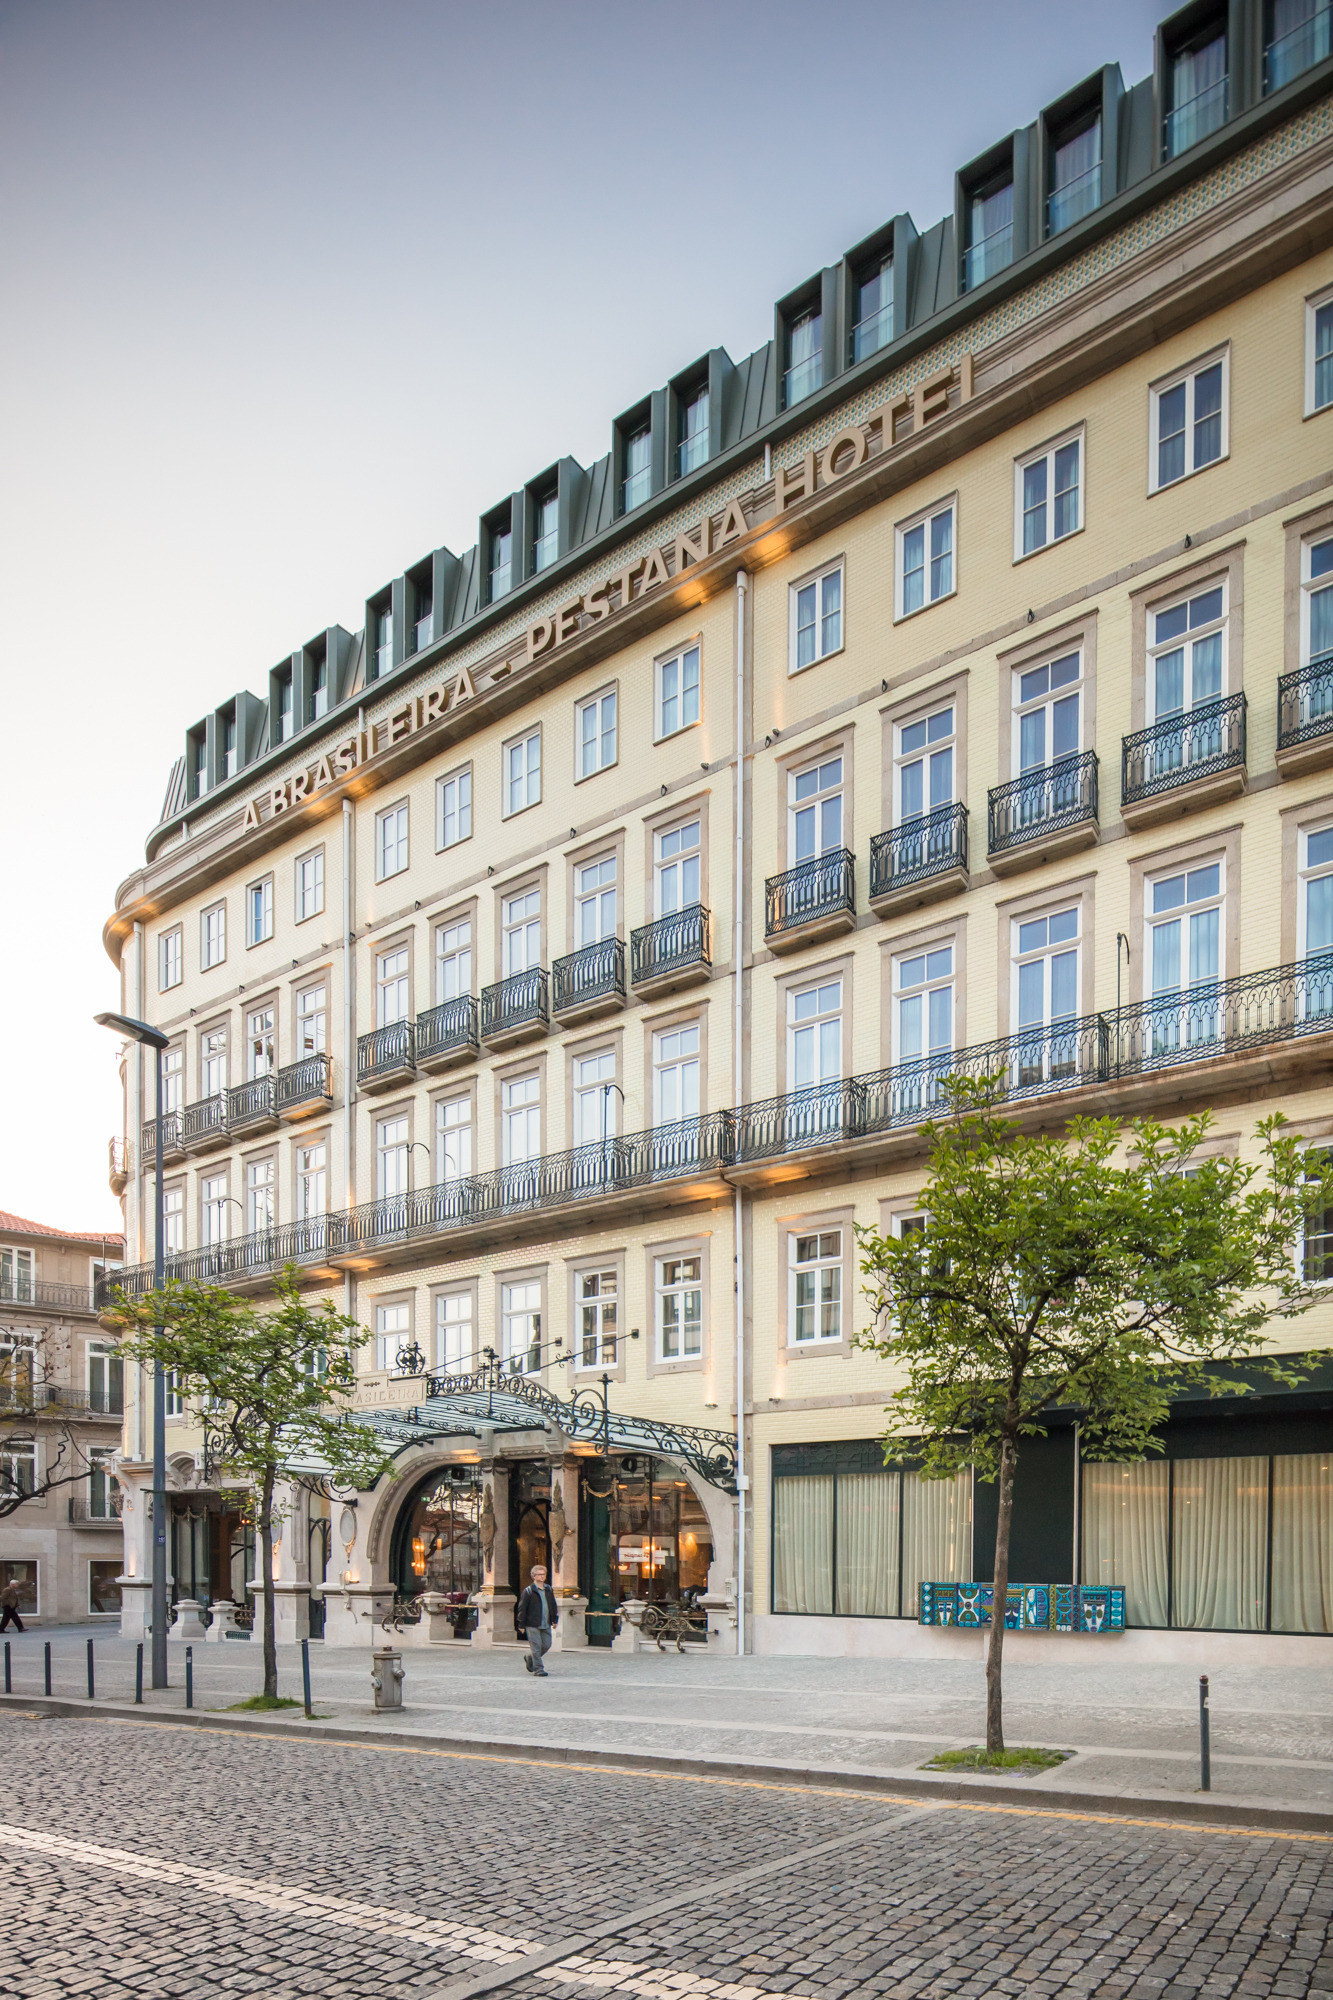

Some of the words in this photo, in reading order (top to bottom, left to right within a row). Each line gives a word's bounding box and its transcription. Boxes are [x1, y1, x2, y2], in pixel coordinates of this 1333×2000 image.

[242, 799, 262, 835] A
[270, 666, 478, 818] BRASILEIRA
[526, 498, 749, 663] PESTANA
[775, 351, 974, 515] HOTEL
